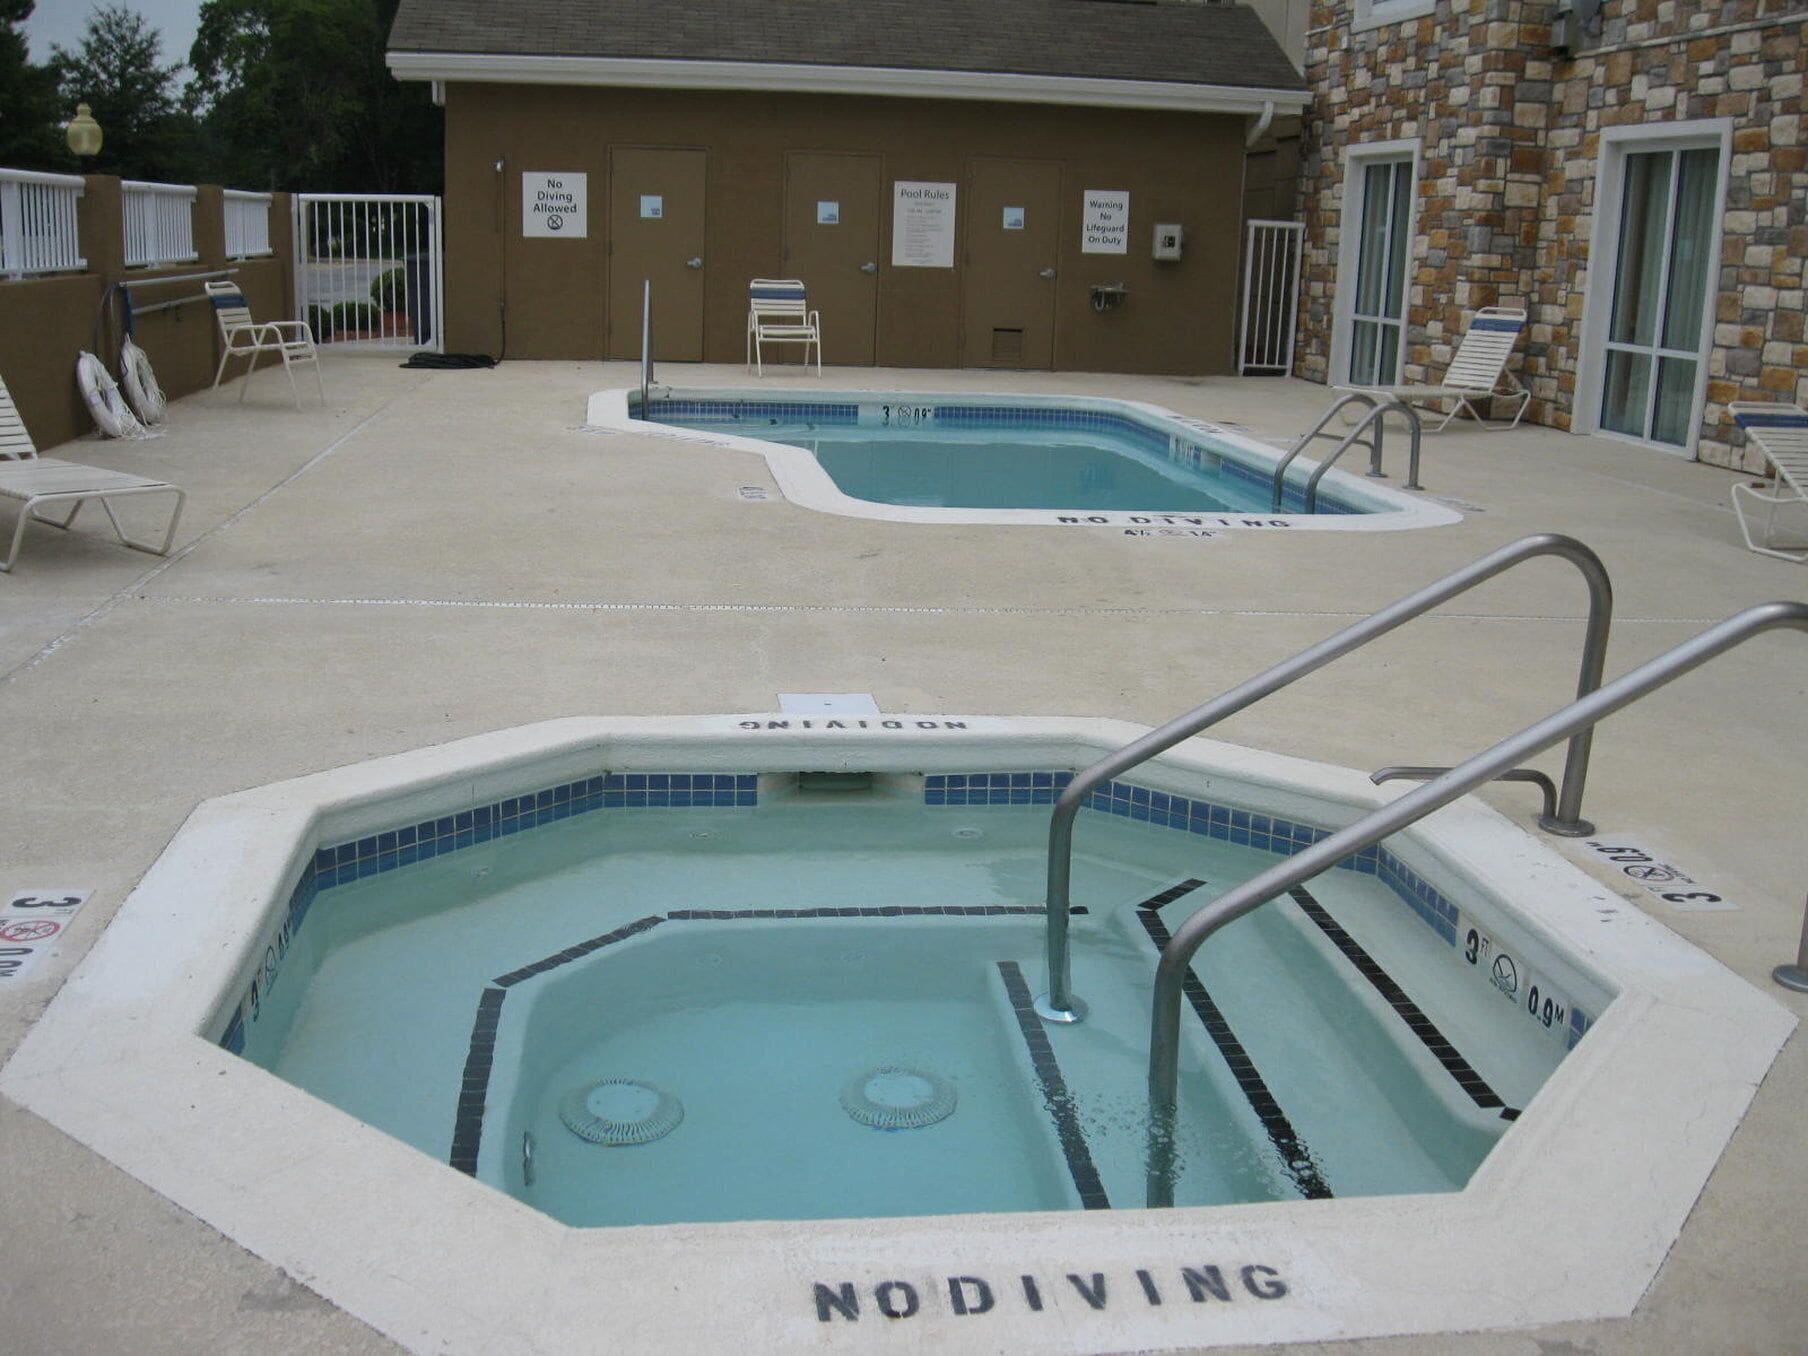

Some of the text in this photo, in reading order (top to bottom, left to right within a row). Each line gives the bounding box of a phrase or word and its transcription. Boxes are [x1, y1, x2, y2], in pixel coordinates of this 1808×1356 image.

[547, 179, 563, 189] No
[537, 191, 573, 203] Diving
[900, 188, 950, 200] Pool Rules
[533, 203, 577, 214] Allowed
[1089, 200, 1124, 211] Warning
[1100, 212, 1112, 221] No
[1086, 224, 1125, 234] Lifeguard
[1088, 236, 1122, 246] On Duty
